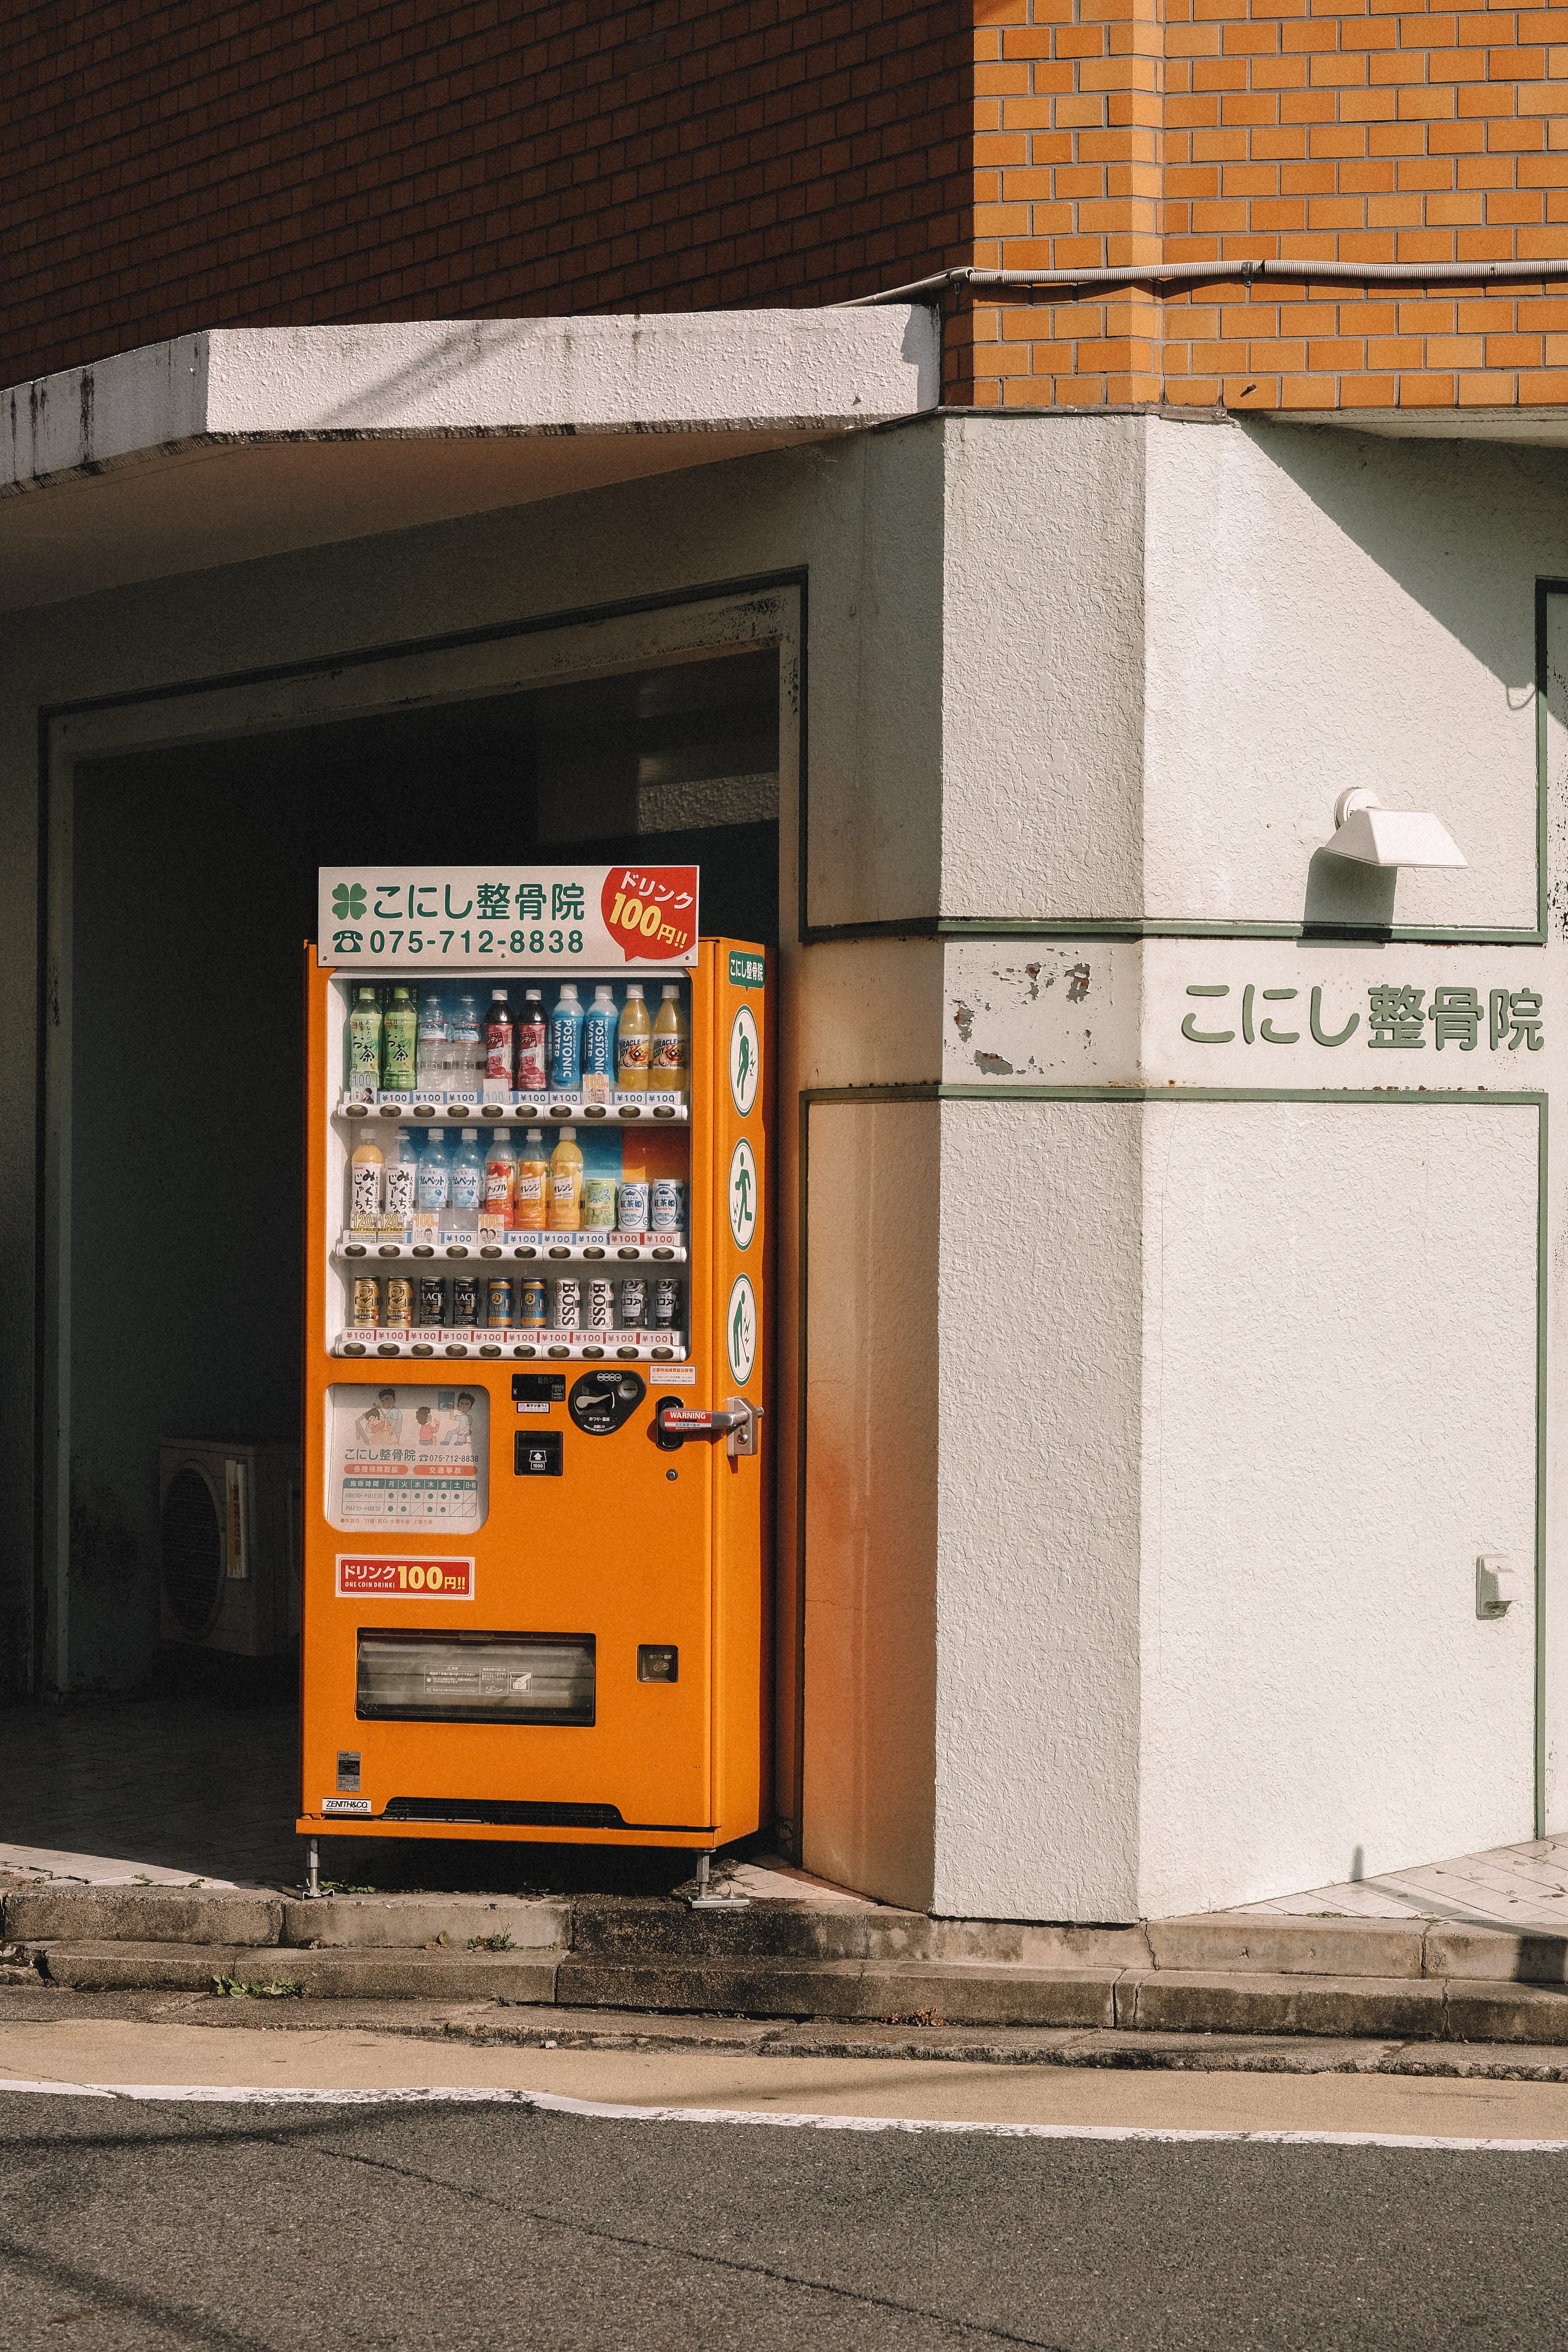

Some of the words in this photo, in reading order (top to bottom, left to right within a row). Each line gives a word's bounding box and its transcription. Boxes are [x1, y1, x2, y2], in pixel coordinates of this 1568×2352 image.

[374, 883, 585, 920] こにし整骨院
[620, 871, 694, 910] ドリンク
[609, 892, 688, 950] 100円!!
[370, 929, 584, 954] 075-712-8838
[730, 959, 763, 981] こにし整骨院
[1181, 983, 1544, 1051] こにし整骨院
[562, 1020, 573, 1078] POSTONIC
[487, 1184, 507, 1193] アップル
[520, 1183, 540, 1193] オレンジ
[554, 1183, 573, 1193] オレンジ
[621, 1200, 642, 1208] 紅茶姫
[562, 1282, 576, 1326] BOSS
[593, 1282, 606, 1326] BOSS
[344, 1448, 416, 1461] こにし整骨院
[345, 1565, 396, 1580] ドリンク
[397, 1565, 465, 1590] 100円!!
